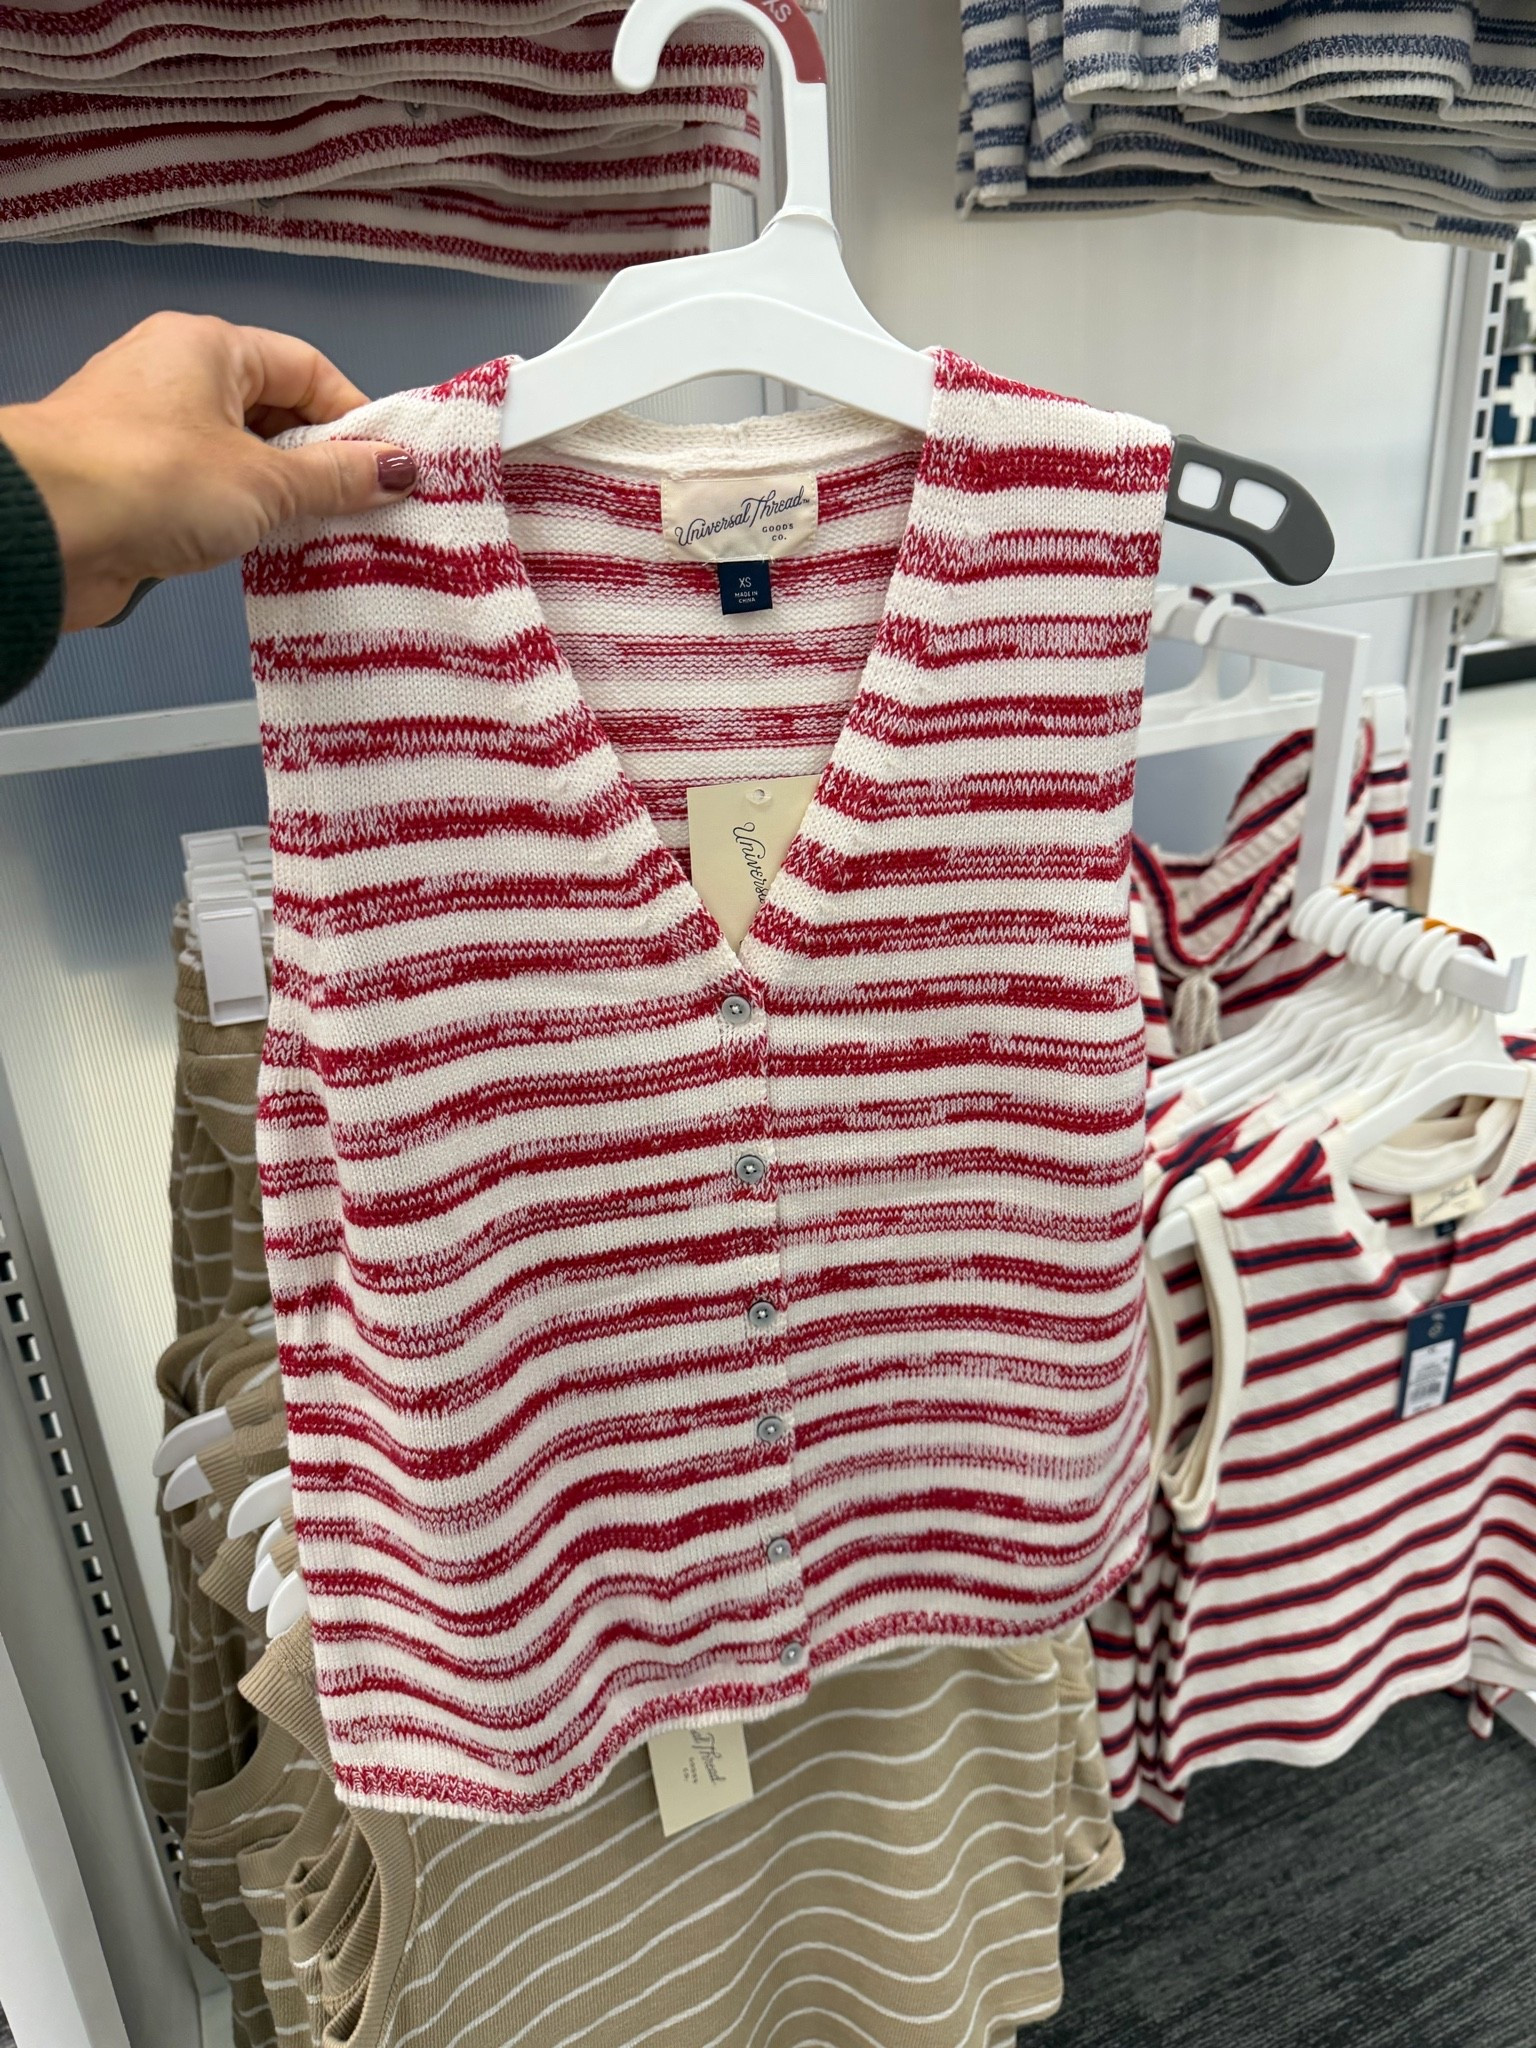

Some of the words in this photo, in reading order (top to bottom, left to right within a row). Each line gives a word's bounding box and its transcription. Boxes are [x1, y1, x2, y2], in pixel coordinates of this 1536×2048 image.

[674, 502, 752, 546] Universal
[762, 522, 794, 533] GOODS
[771, 534, 787, 542] CO.
[738, 576, 752, 588] XS
[732, 821, 769, 904] Universa
